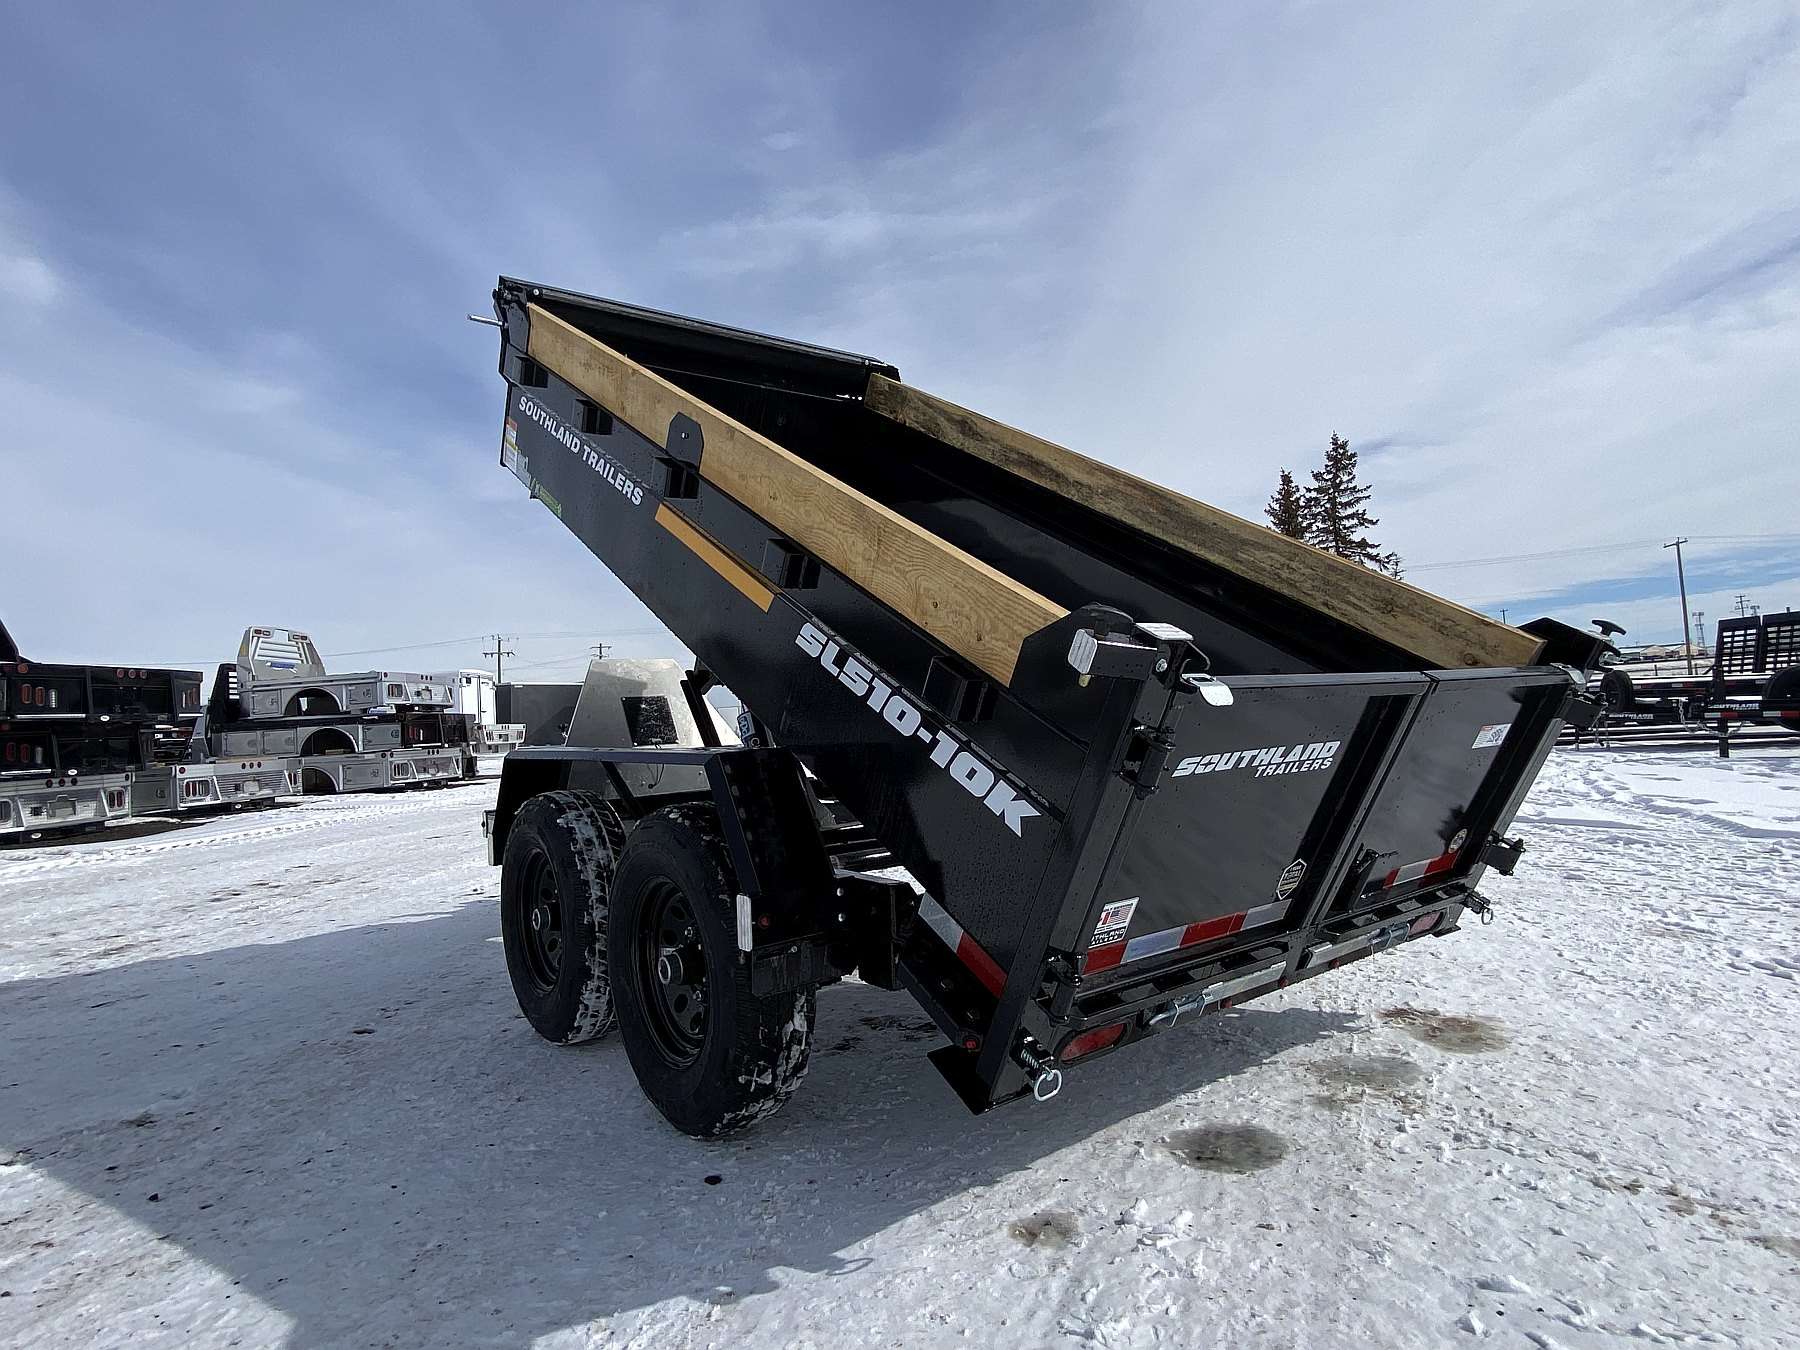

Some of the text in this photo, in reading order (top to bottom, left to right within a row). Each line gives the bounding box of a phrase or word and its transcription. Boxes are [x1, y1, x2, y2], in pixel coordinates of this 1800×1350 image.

[518, 396, 581, 454] SOUTHLAND
[582, 445, 644, 506] TRAILERS
[795, 622, 1042, 838] SL510-10K
[1171, 740, 1341, 778] SOUTHLAND
[1254, 757, 1334, 778] TRAILERS
